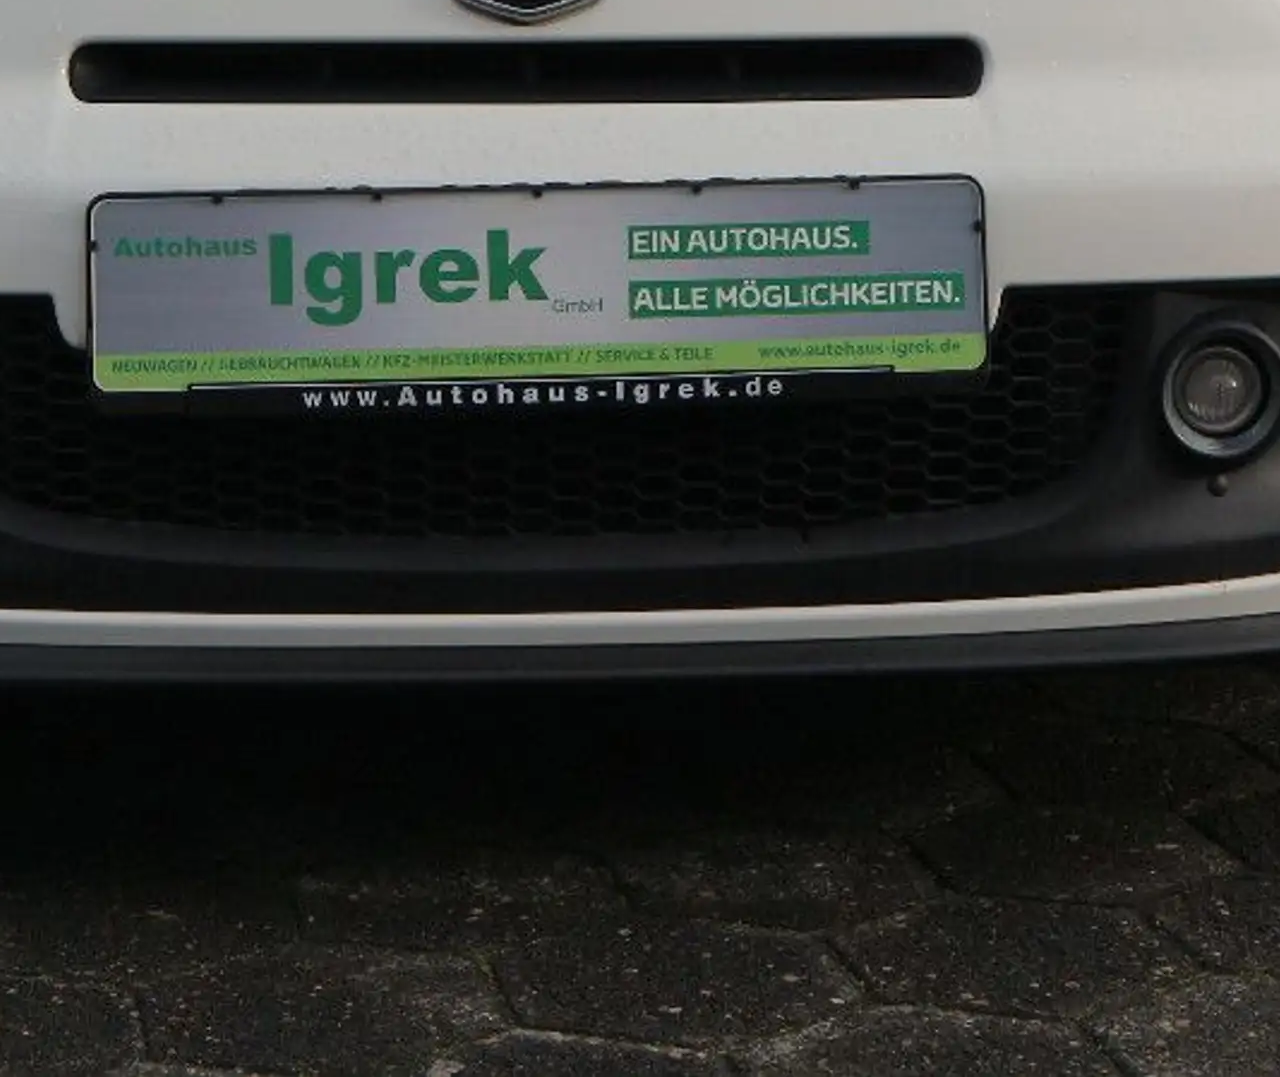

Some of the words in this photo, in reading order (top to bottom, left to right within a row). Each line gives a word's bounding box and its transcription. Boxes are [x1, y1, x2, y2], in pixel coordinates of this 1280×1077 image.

[632, 230, 680, 254] EIN
[687, 225, 858, 253] AUTOHAUS.
[113, 236, 257, 257] Autohaus
[268, 230, 549, 327] Igrek
[552, 298, 604, 313] GmbH
[634, 286, 708, 311] ALLE
[716, 279, 961, 309] MÖGLICHKEITEN.
[596, 349, 654, 364] SERVICE
[674, 346, 714, 362] TEILE
[303, 378, 784, 408] www.Autohaus-Igrek.de
